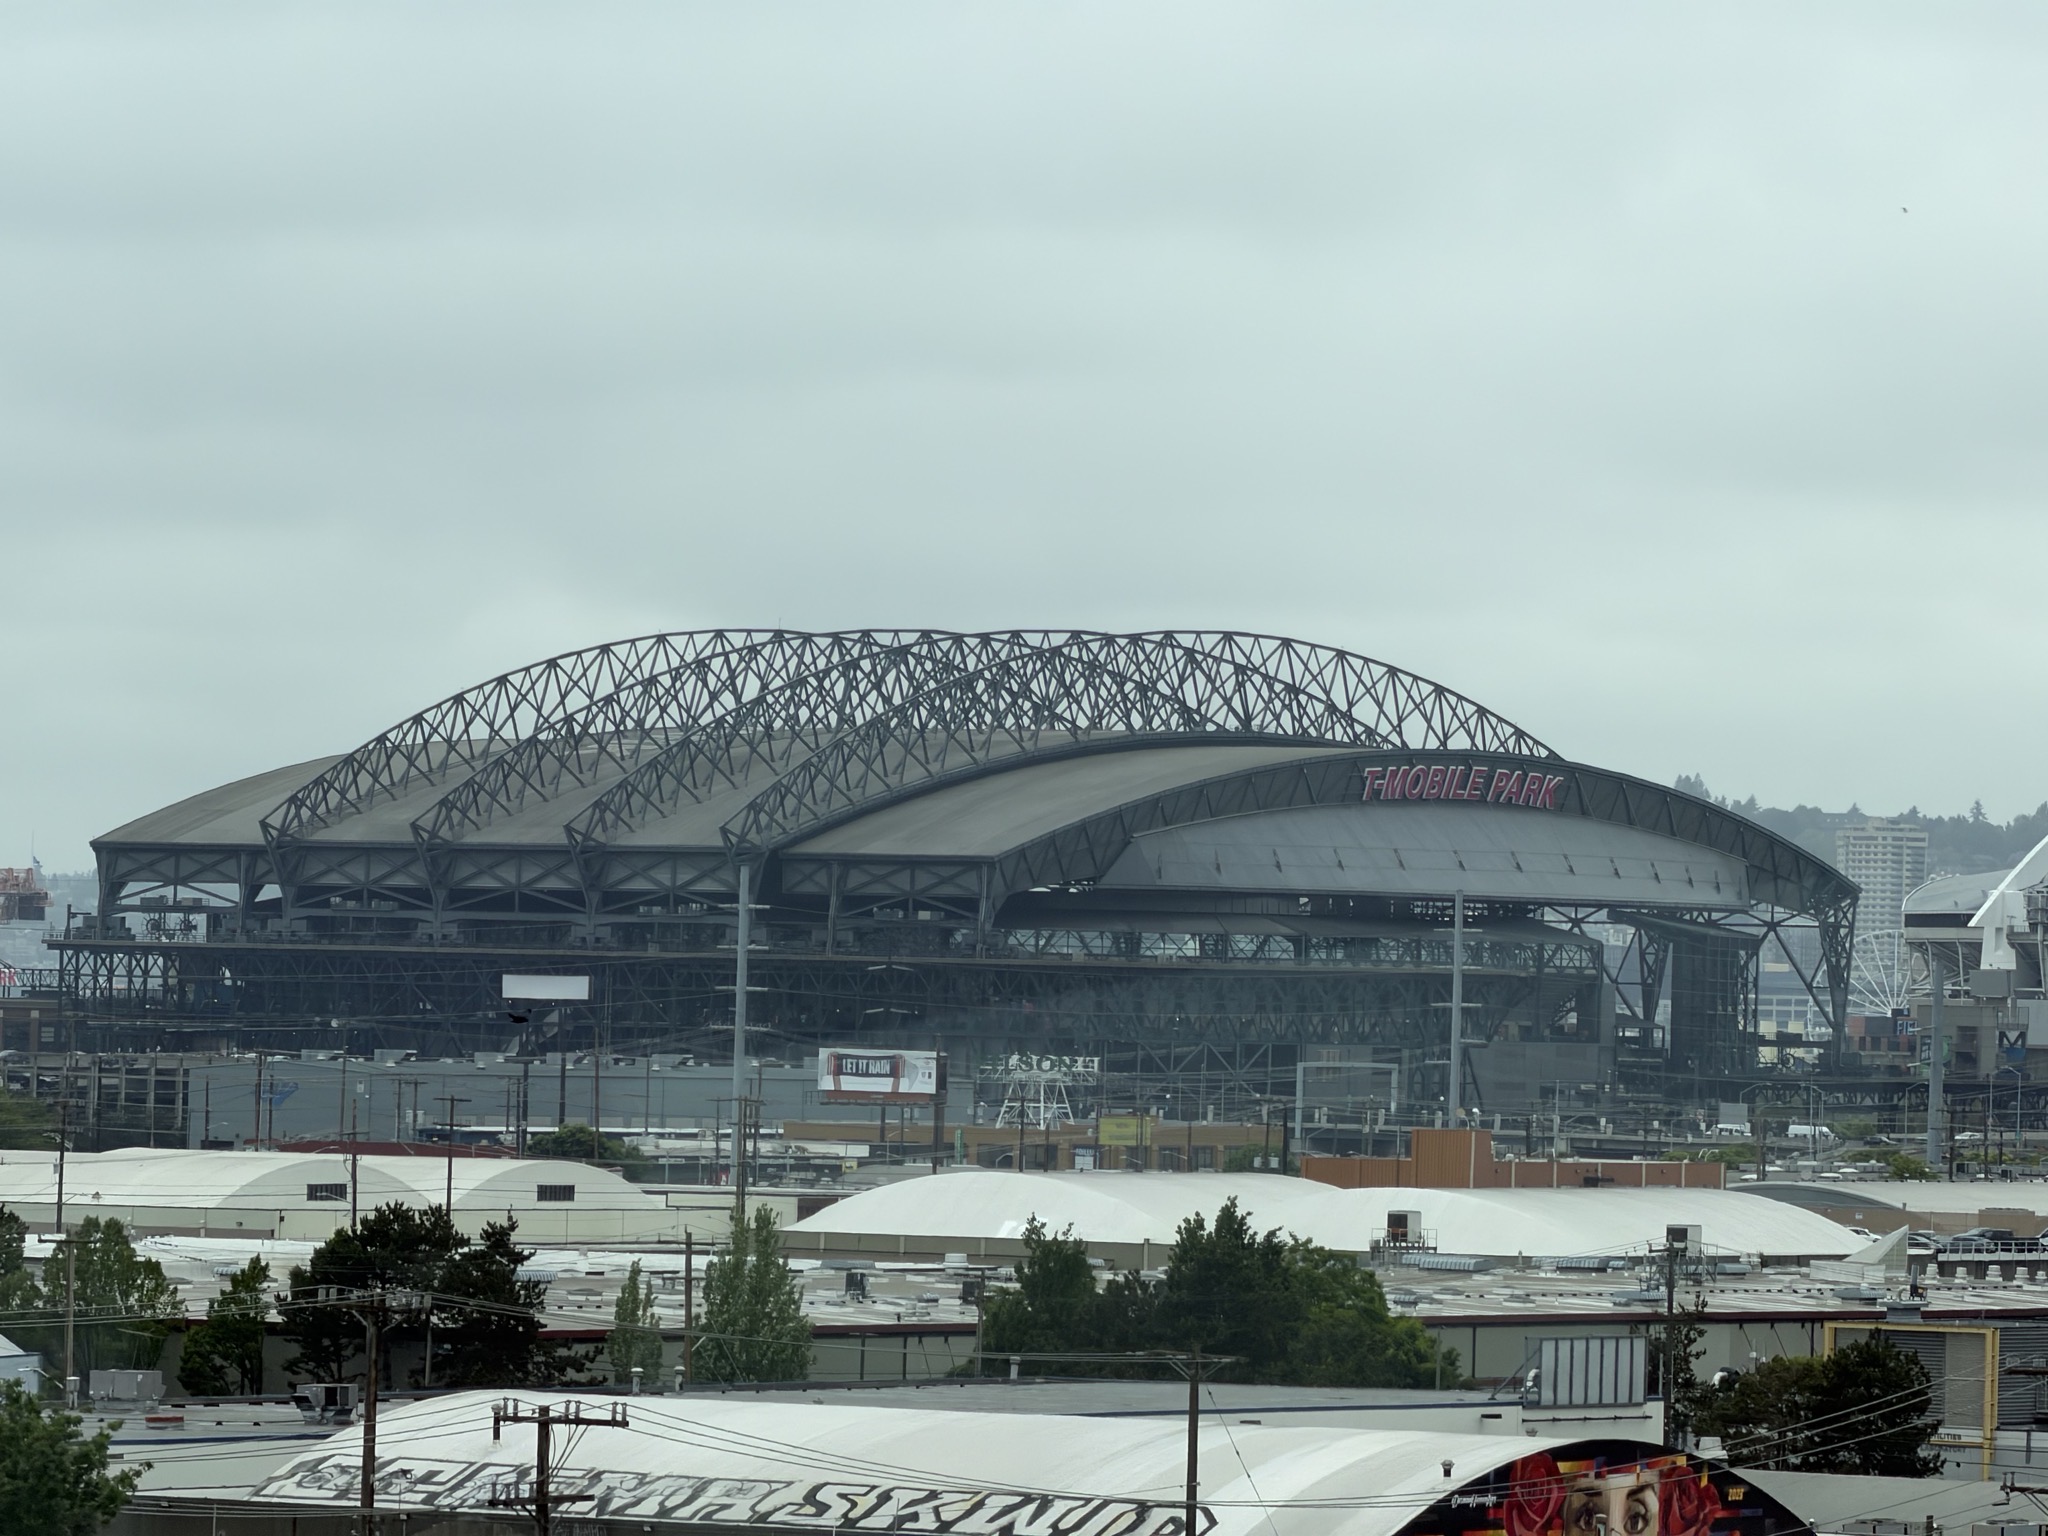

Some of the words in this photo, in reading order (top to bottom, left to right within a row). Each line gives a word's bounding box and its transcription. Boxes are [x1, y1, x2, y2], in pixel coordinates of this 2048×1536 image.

[1363, 765, 1488, 801] T-MOBILE
[1487, 769, 1564, 809] PARK
[842, 1058, 857, 1074] LET
[858, 1058, 868, 1074] IT
[868, 1059, 890, 1075] RAIN
